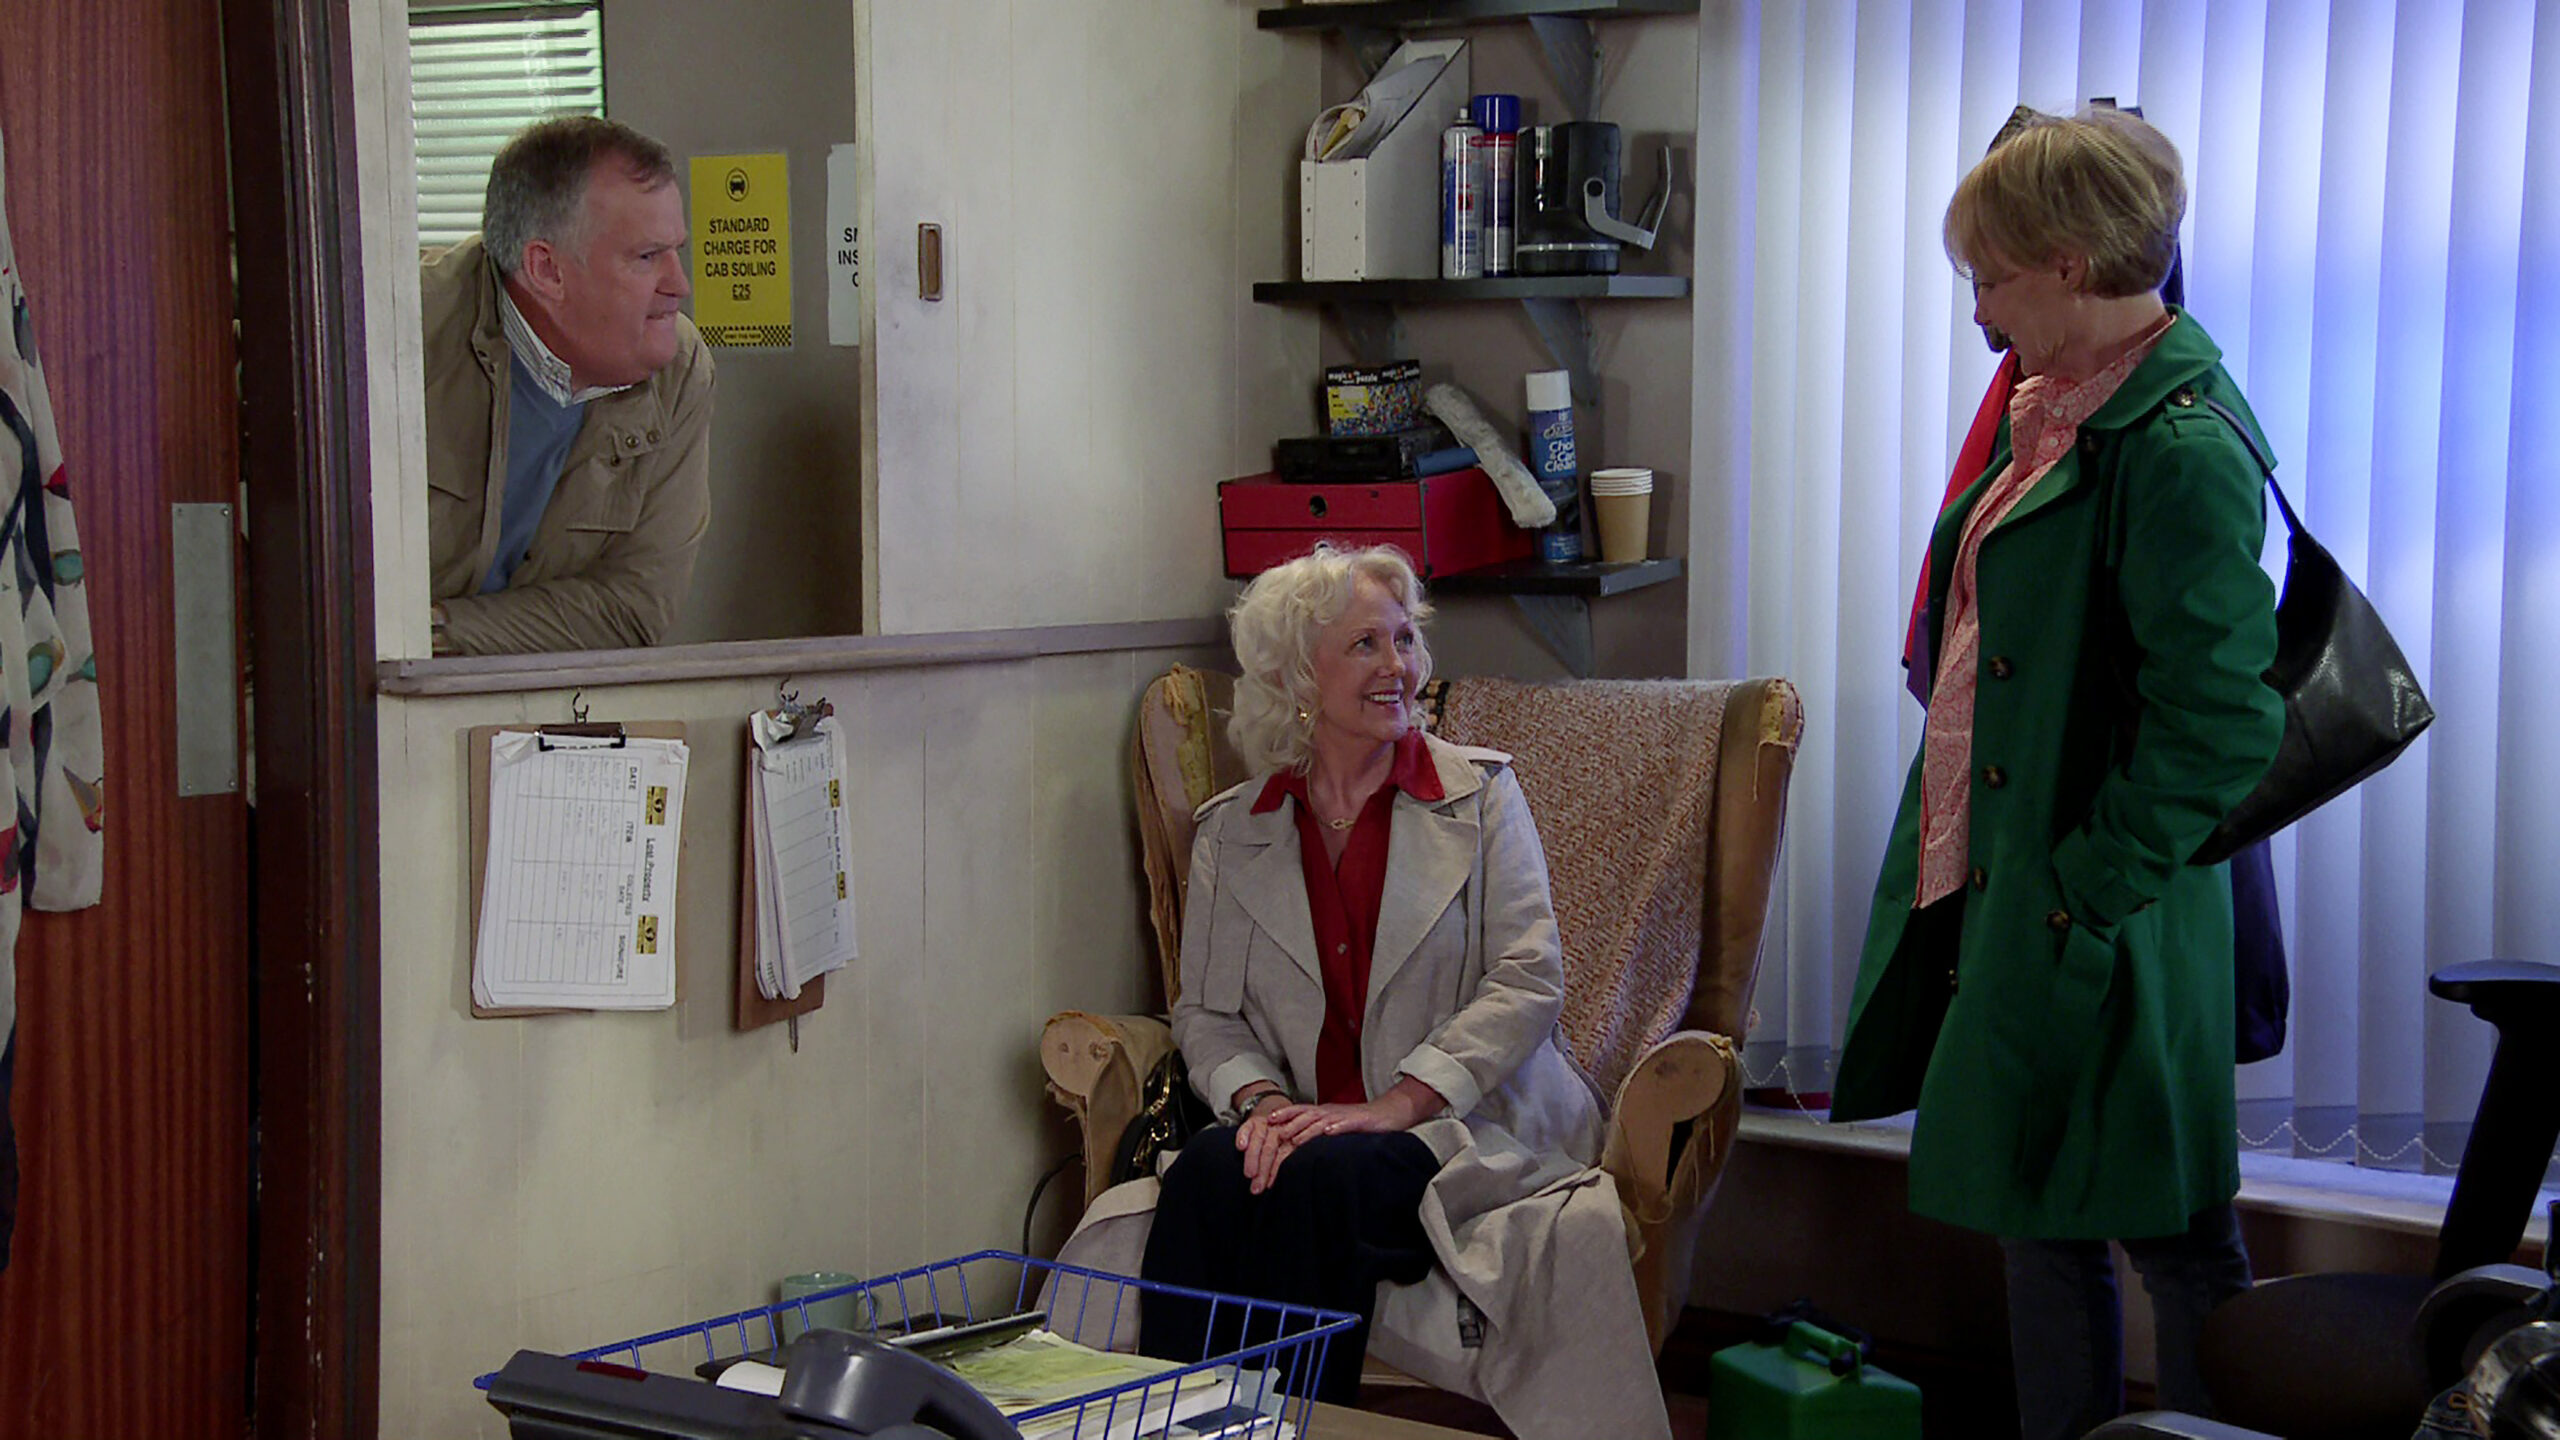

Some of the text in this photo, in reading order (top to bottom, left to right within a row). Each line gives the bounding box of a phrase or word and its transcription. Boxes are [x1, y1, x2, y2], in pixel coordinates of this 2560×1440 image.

[709, 217, 770, 235] STANDARD
[703, 239, 777, 256] CHARGE FOR
[705, 260, 777, 277] CAB SOILING
[732, 283, 752, 301] £25
[628, 766, 637, 790] DATE
